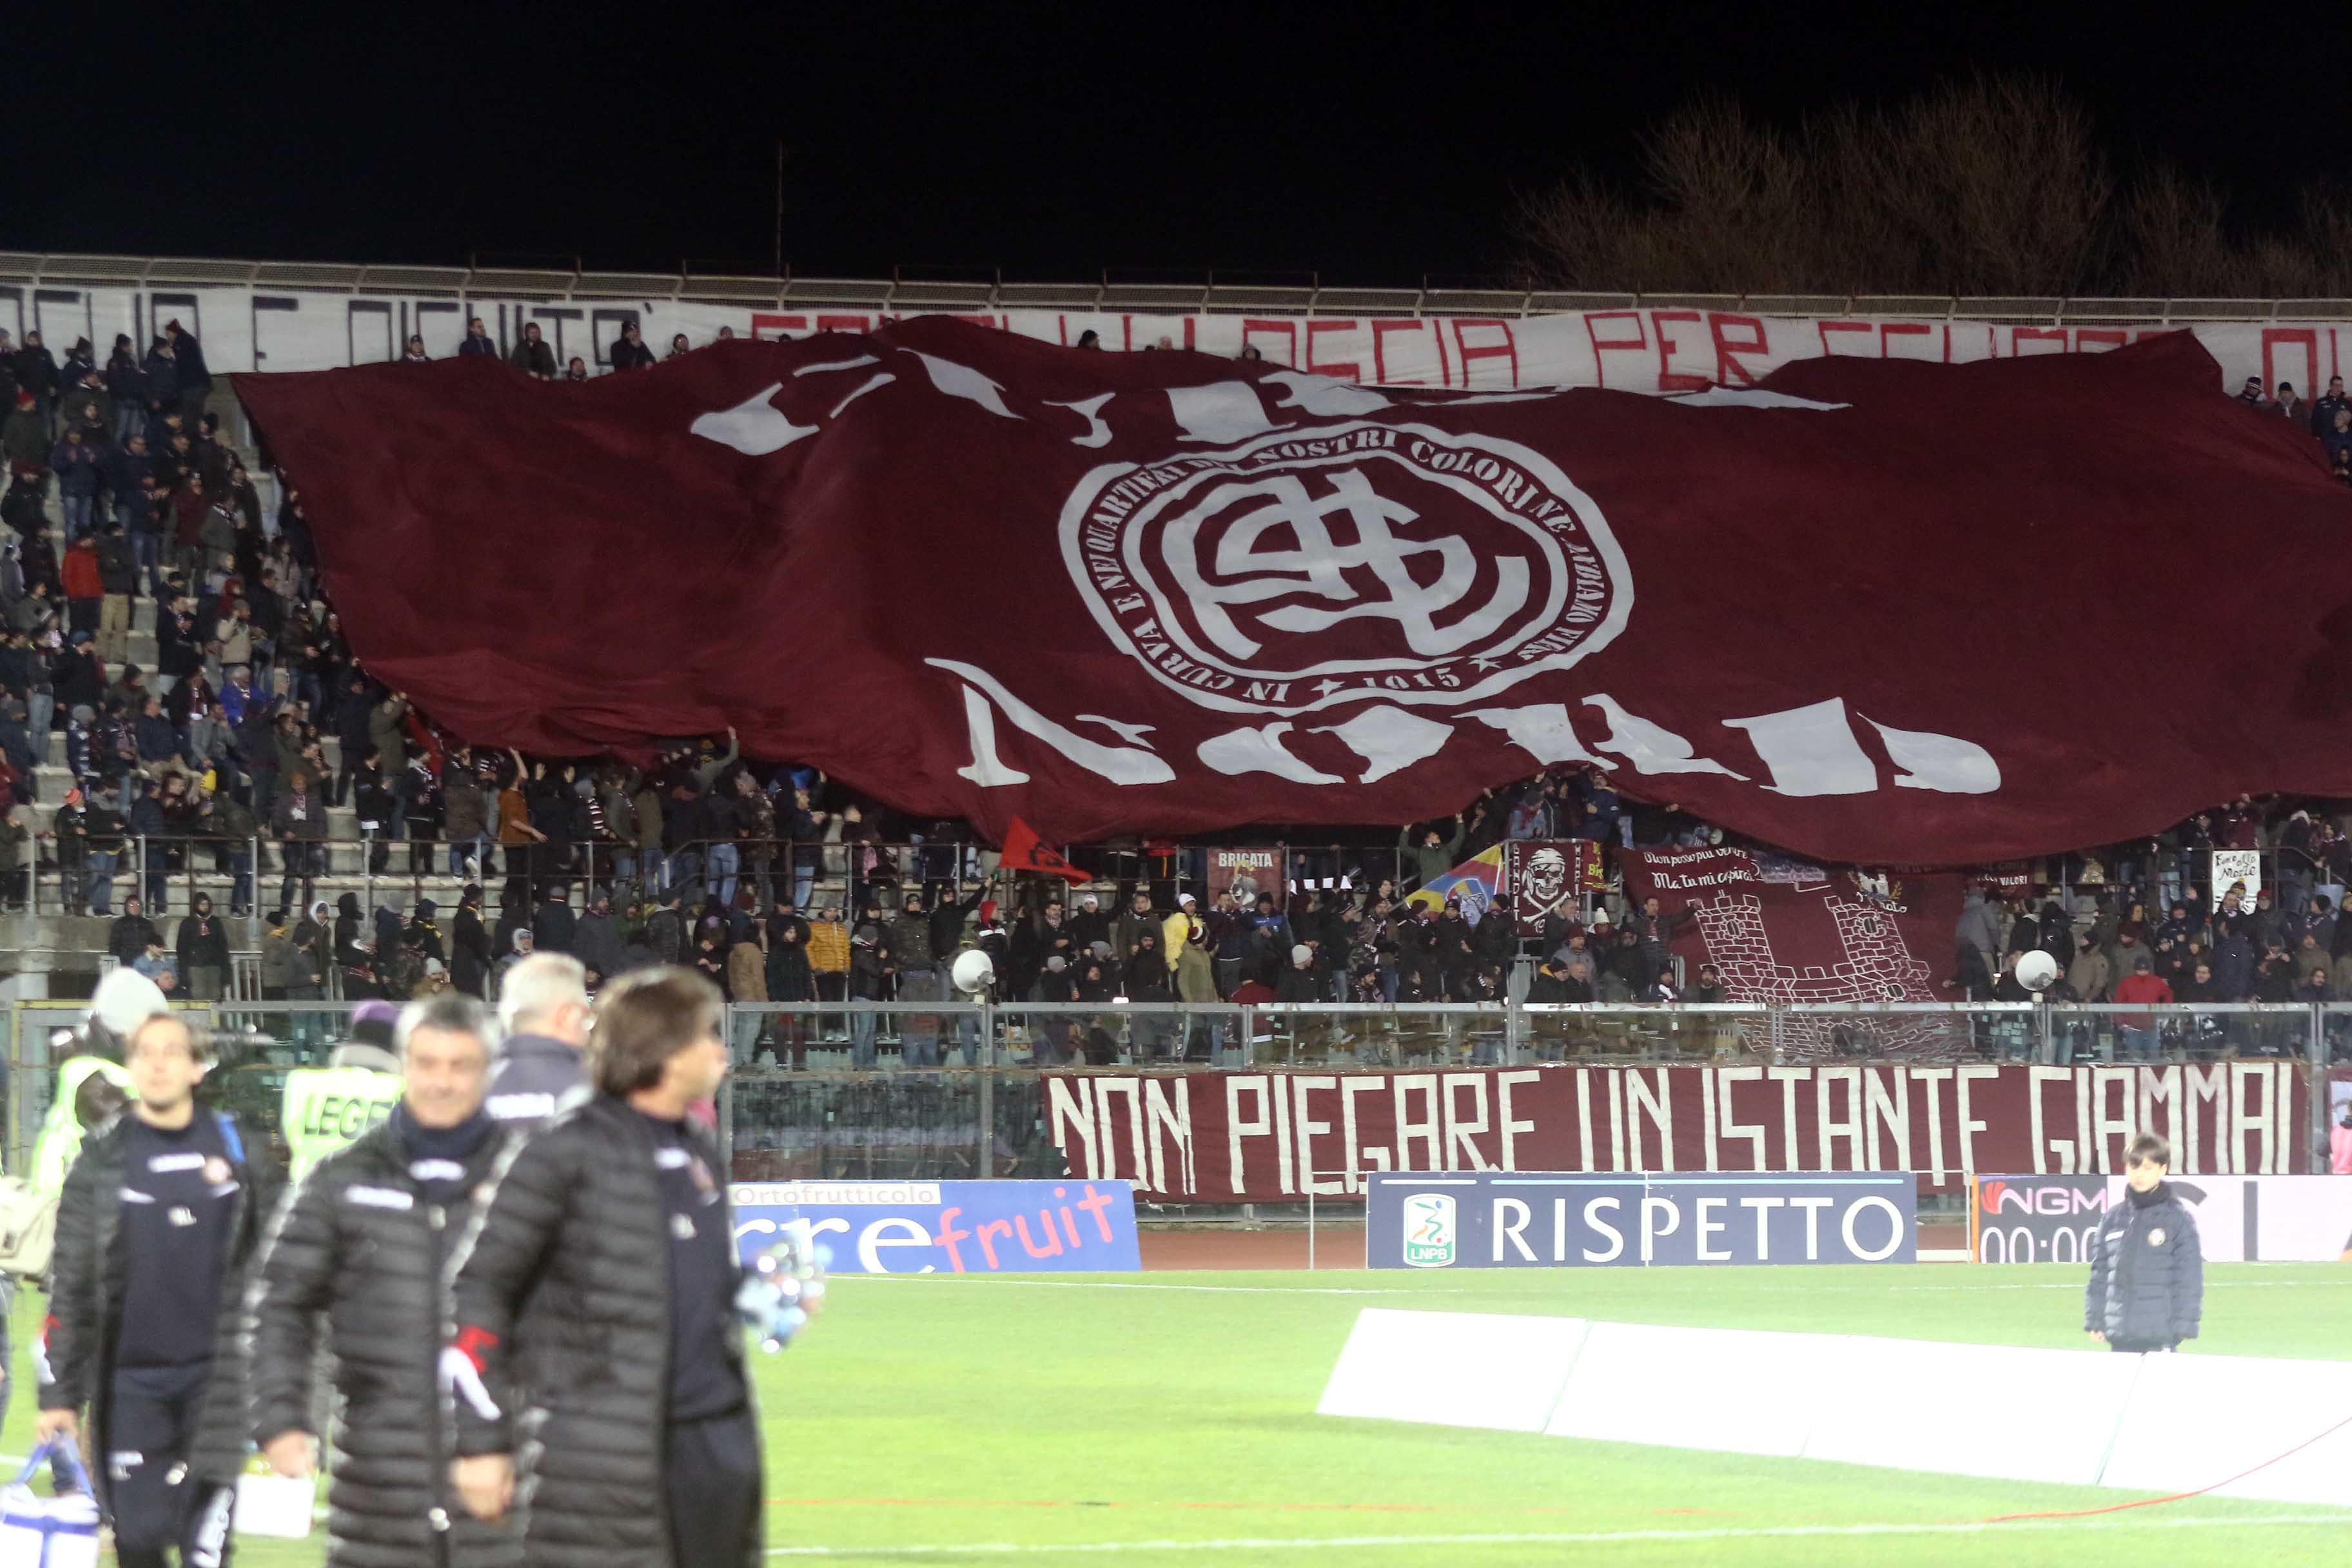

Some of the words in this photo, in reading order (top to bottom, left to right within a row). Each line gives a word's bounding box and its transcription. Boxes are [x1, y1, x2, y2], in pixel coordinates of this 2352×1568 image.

[1583, 311, 1769, 391] PER
[1253, 429, 1398, 465] NOSTRI
[1411, 441, 1539, 509] COLORI
[1133, 617, 1235, 690] CURVA
[1242, 681, 1290, 701] IN
[1218, 852, 1273, 867] BRIGATA
[1680, 874, 1698, 888] tu
[1699, 872, 1716, 886] mi
[1048, 1077, 1197, 1195] NON
[1227, 1070, 1540, 1194] PIEGARE
[1702, 1065, 1999, 1186] ISTANTE
[2029, 1063, 2292, 1175] GIAMMAI
[736, 1186, 934, 1204] Ortofrutticolo
[1997, 1187, 2108, 1215] NGM
[1492, 1196, 1904, 1262] RISPETTO
[1411, 1248, 1448, 1260] LNPB
